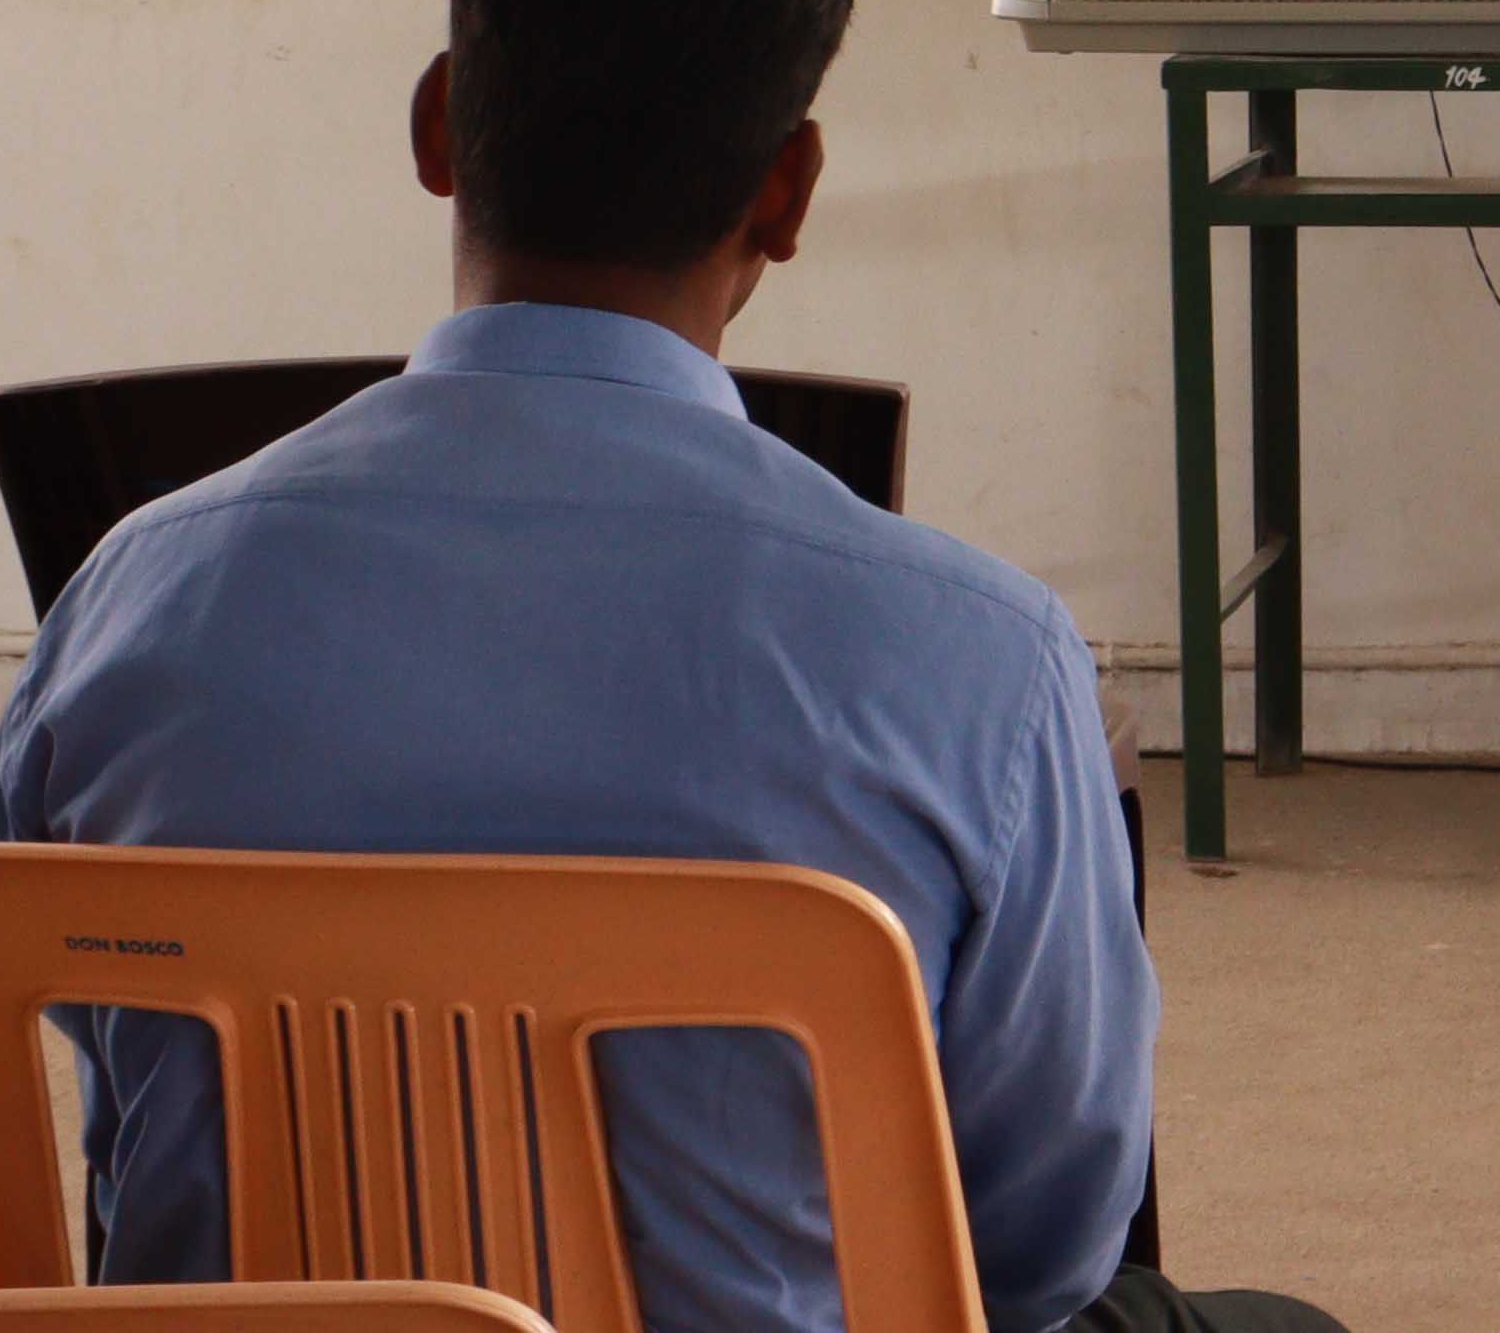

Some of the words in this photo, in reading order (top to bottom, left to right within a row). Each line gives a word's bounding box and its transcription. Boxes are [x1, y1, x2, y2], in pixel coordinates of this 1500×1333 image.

[1445, 64, 1487, 90] 104
[64, 935, 111, 952] DON
[116, 938, 185, 957] BOSCO
